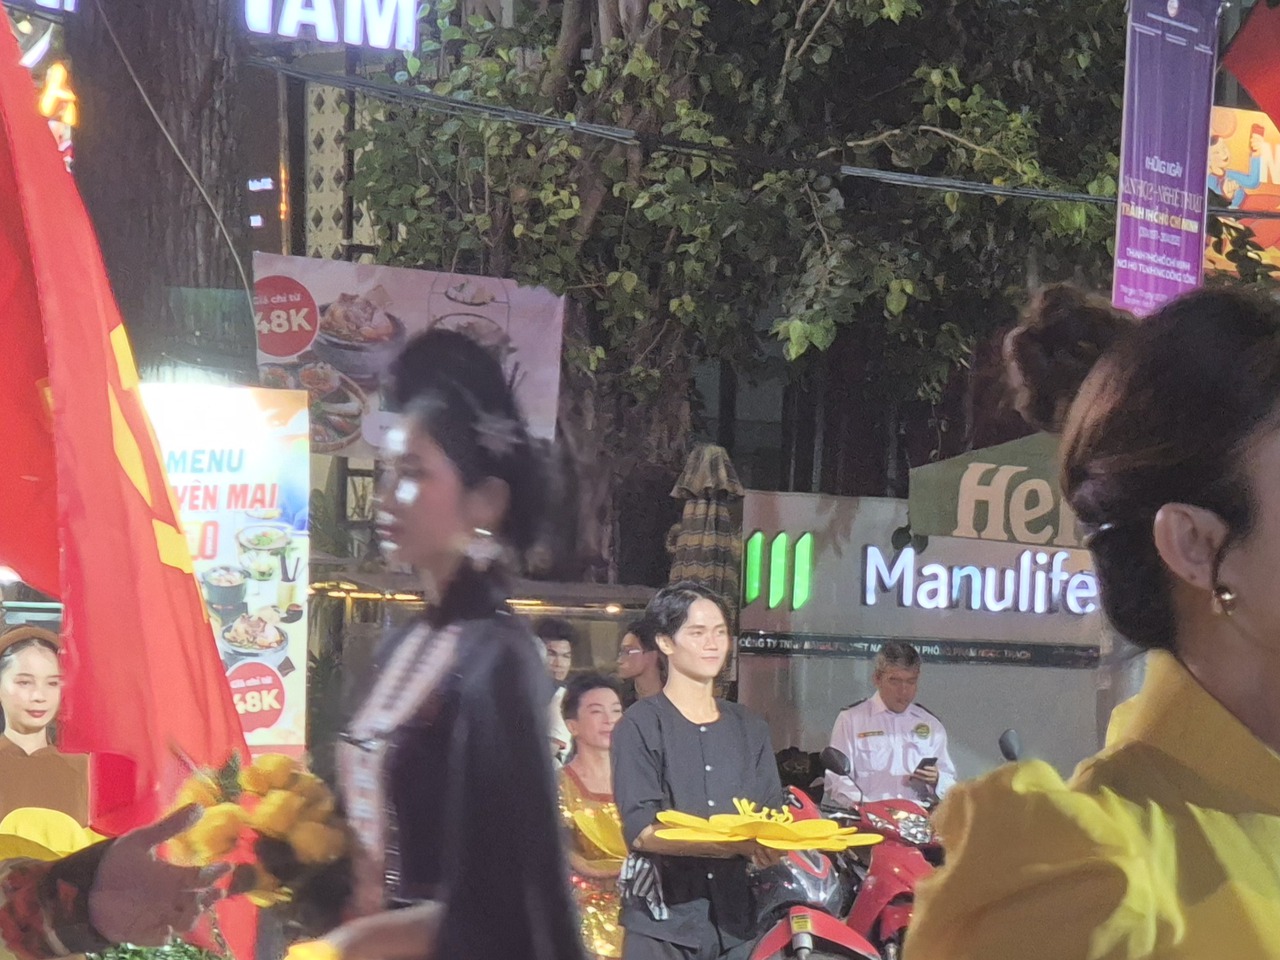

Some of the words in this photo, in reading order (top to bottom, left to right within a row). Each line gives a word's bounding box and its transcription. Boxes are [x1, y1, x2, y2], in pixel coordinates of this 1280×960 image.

[255, 307, 314, 334] 48K
[166, 448, 245, 474] MENU
[865, 546, 1098, 614] Manulife
[233, 689, 282, 714] 48K
